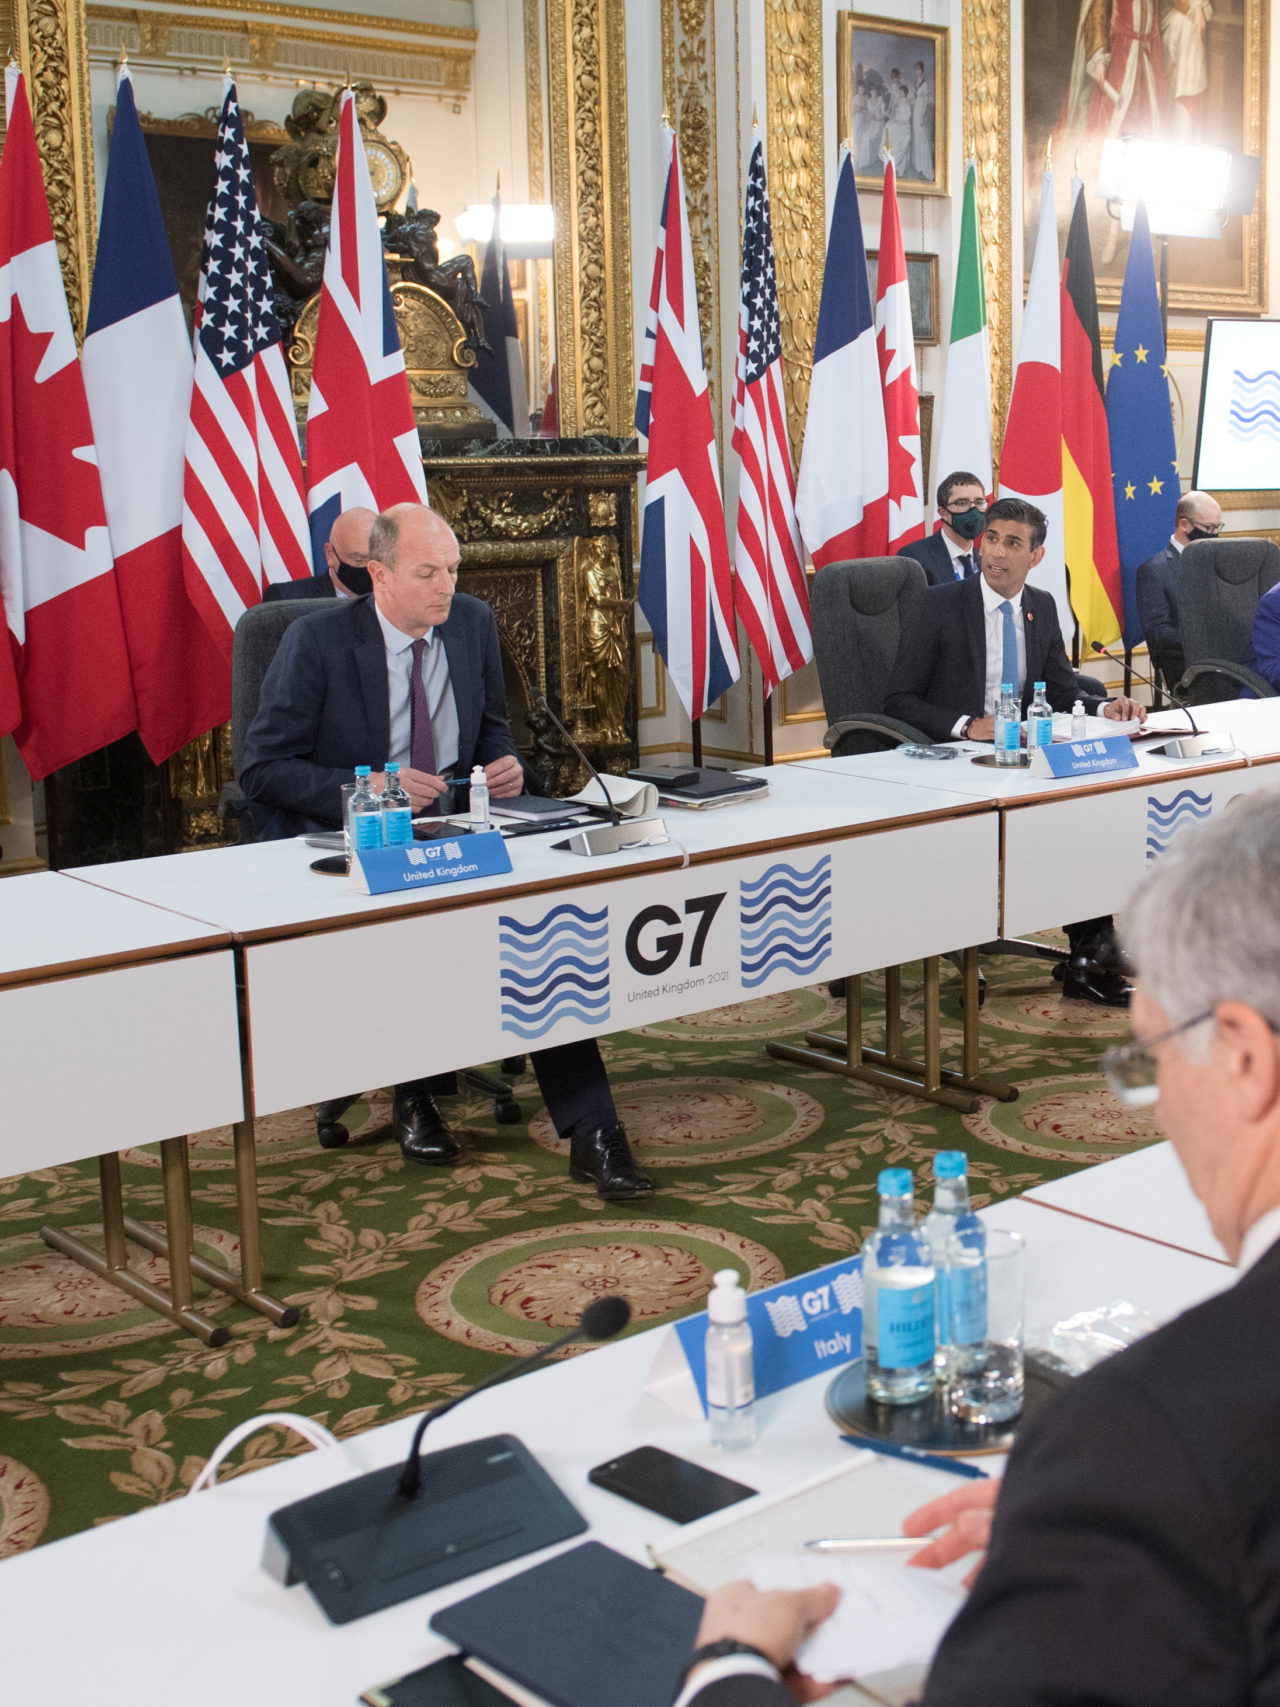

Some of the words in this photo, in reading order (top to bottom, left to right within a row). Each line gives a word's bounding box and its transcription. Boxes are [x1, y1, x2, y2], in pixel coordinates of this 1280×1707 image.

[1072, 760, 1091, 769] United
[1091, 758, 1118, 768] Kingdom
[425, 846, 441, 858] G7
[403, 868, 434, 882] United
[436, 864, 478, 877] Kingdom
[625, 892, 727, 976] G7
[628, 986, 659, 1002] United
[662, 978, 704, 994] Kingdom
[708, 971, 729, 984] 2021
[801, 1284, 830, 1315] G7
[813, 1330, 851, 1360] Italy
